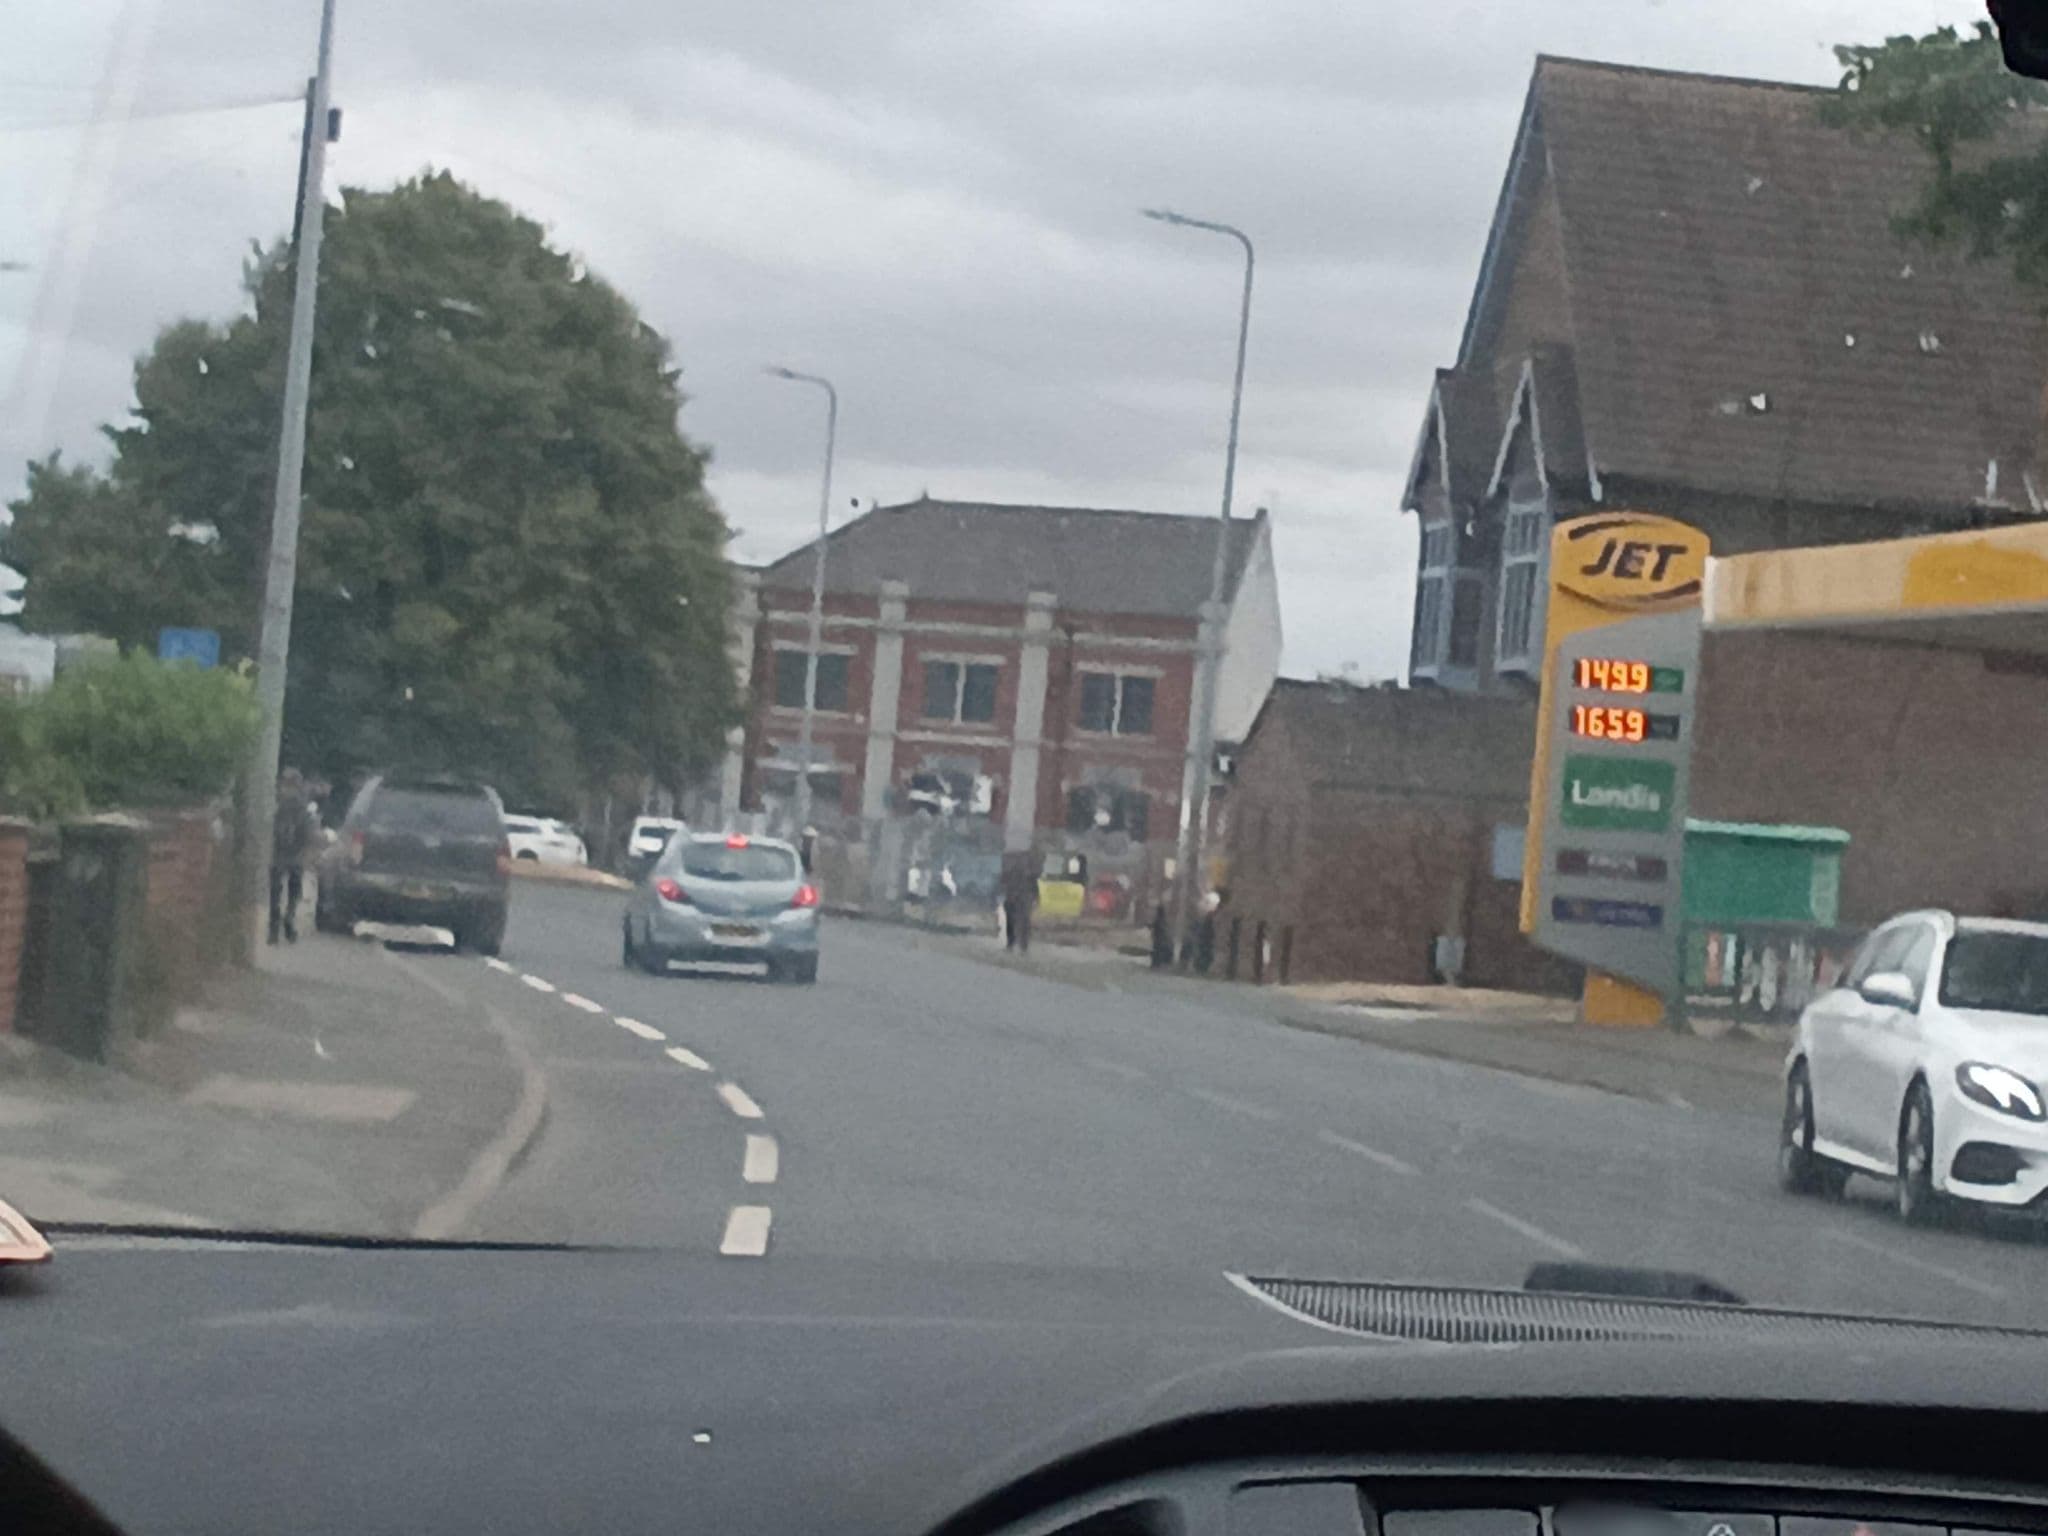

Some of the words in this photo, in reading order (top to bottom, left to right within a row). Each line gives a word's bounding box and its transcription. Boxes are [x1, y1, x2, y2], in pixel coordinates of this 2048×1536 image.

[1580, 538, 1688, 581] JET
[1580, 658, 1649, 693] 1499
[1576, 705, 1644, 741] 1659
